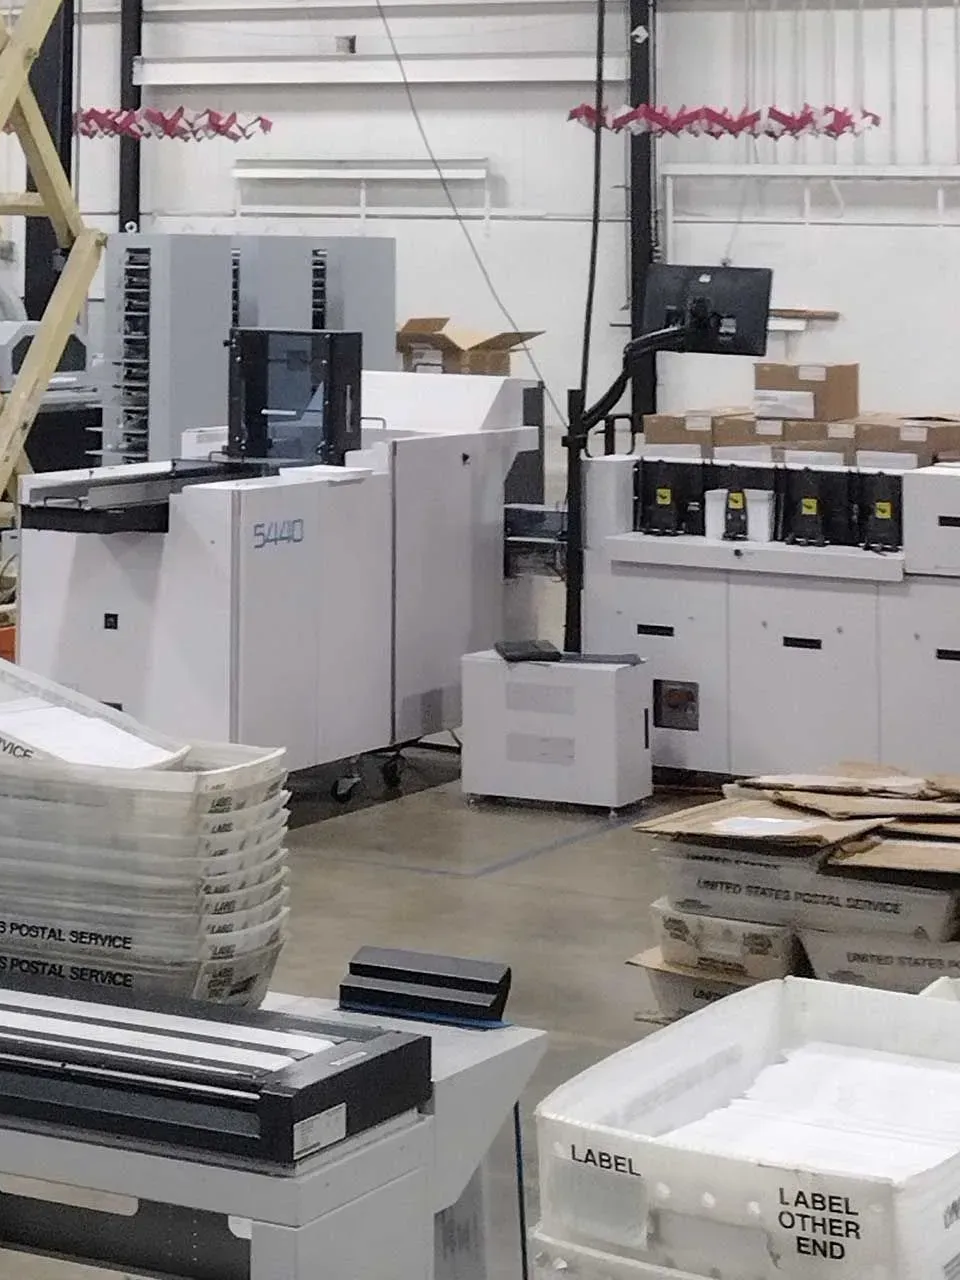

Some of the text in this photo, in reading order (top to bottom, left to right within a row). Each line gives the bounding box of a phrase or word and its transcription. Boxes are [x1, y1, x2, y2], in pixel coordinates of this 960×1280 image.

[253, 518, 304, 549] 5440
[697, 879, 902, 914] UNITED STATES POSTAL SERVICE
[10, 922, 66, 941] POSTAL
[69, 930, 132, 950] SERVICE
[10, 956, 66, 978] POSTAL
[69, 966, 133, 987] SERVICE
[846, 952, 894, 966] UNITED
[898, 956, 945, 970] STATES
[571, 1144, 642, 1177] LABEL
[778, 1187, 859, 1216] LABEL
[778, 1210, 861, 1240] OTHER
[796, 1236, 846, 1261] END
